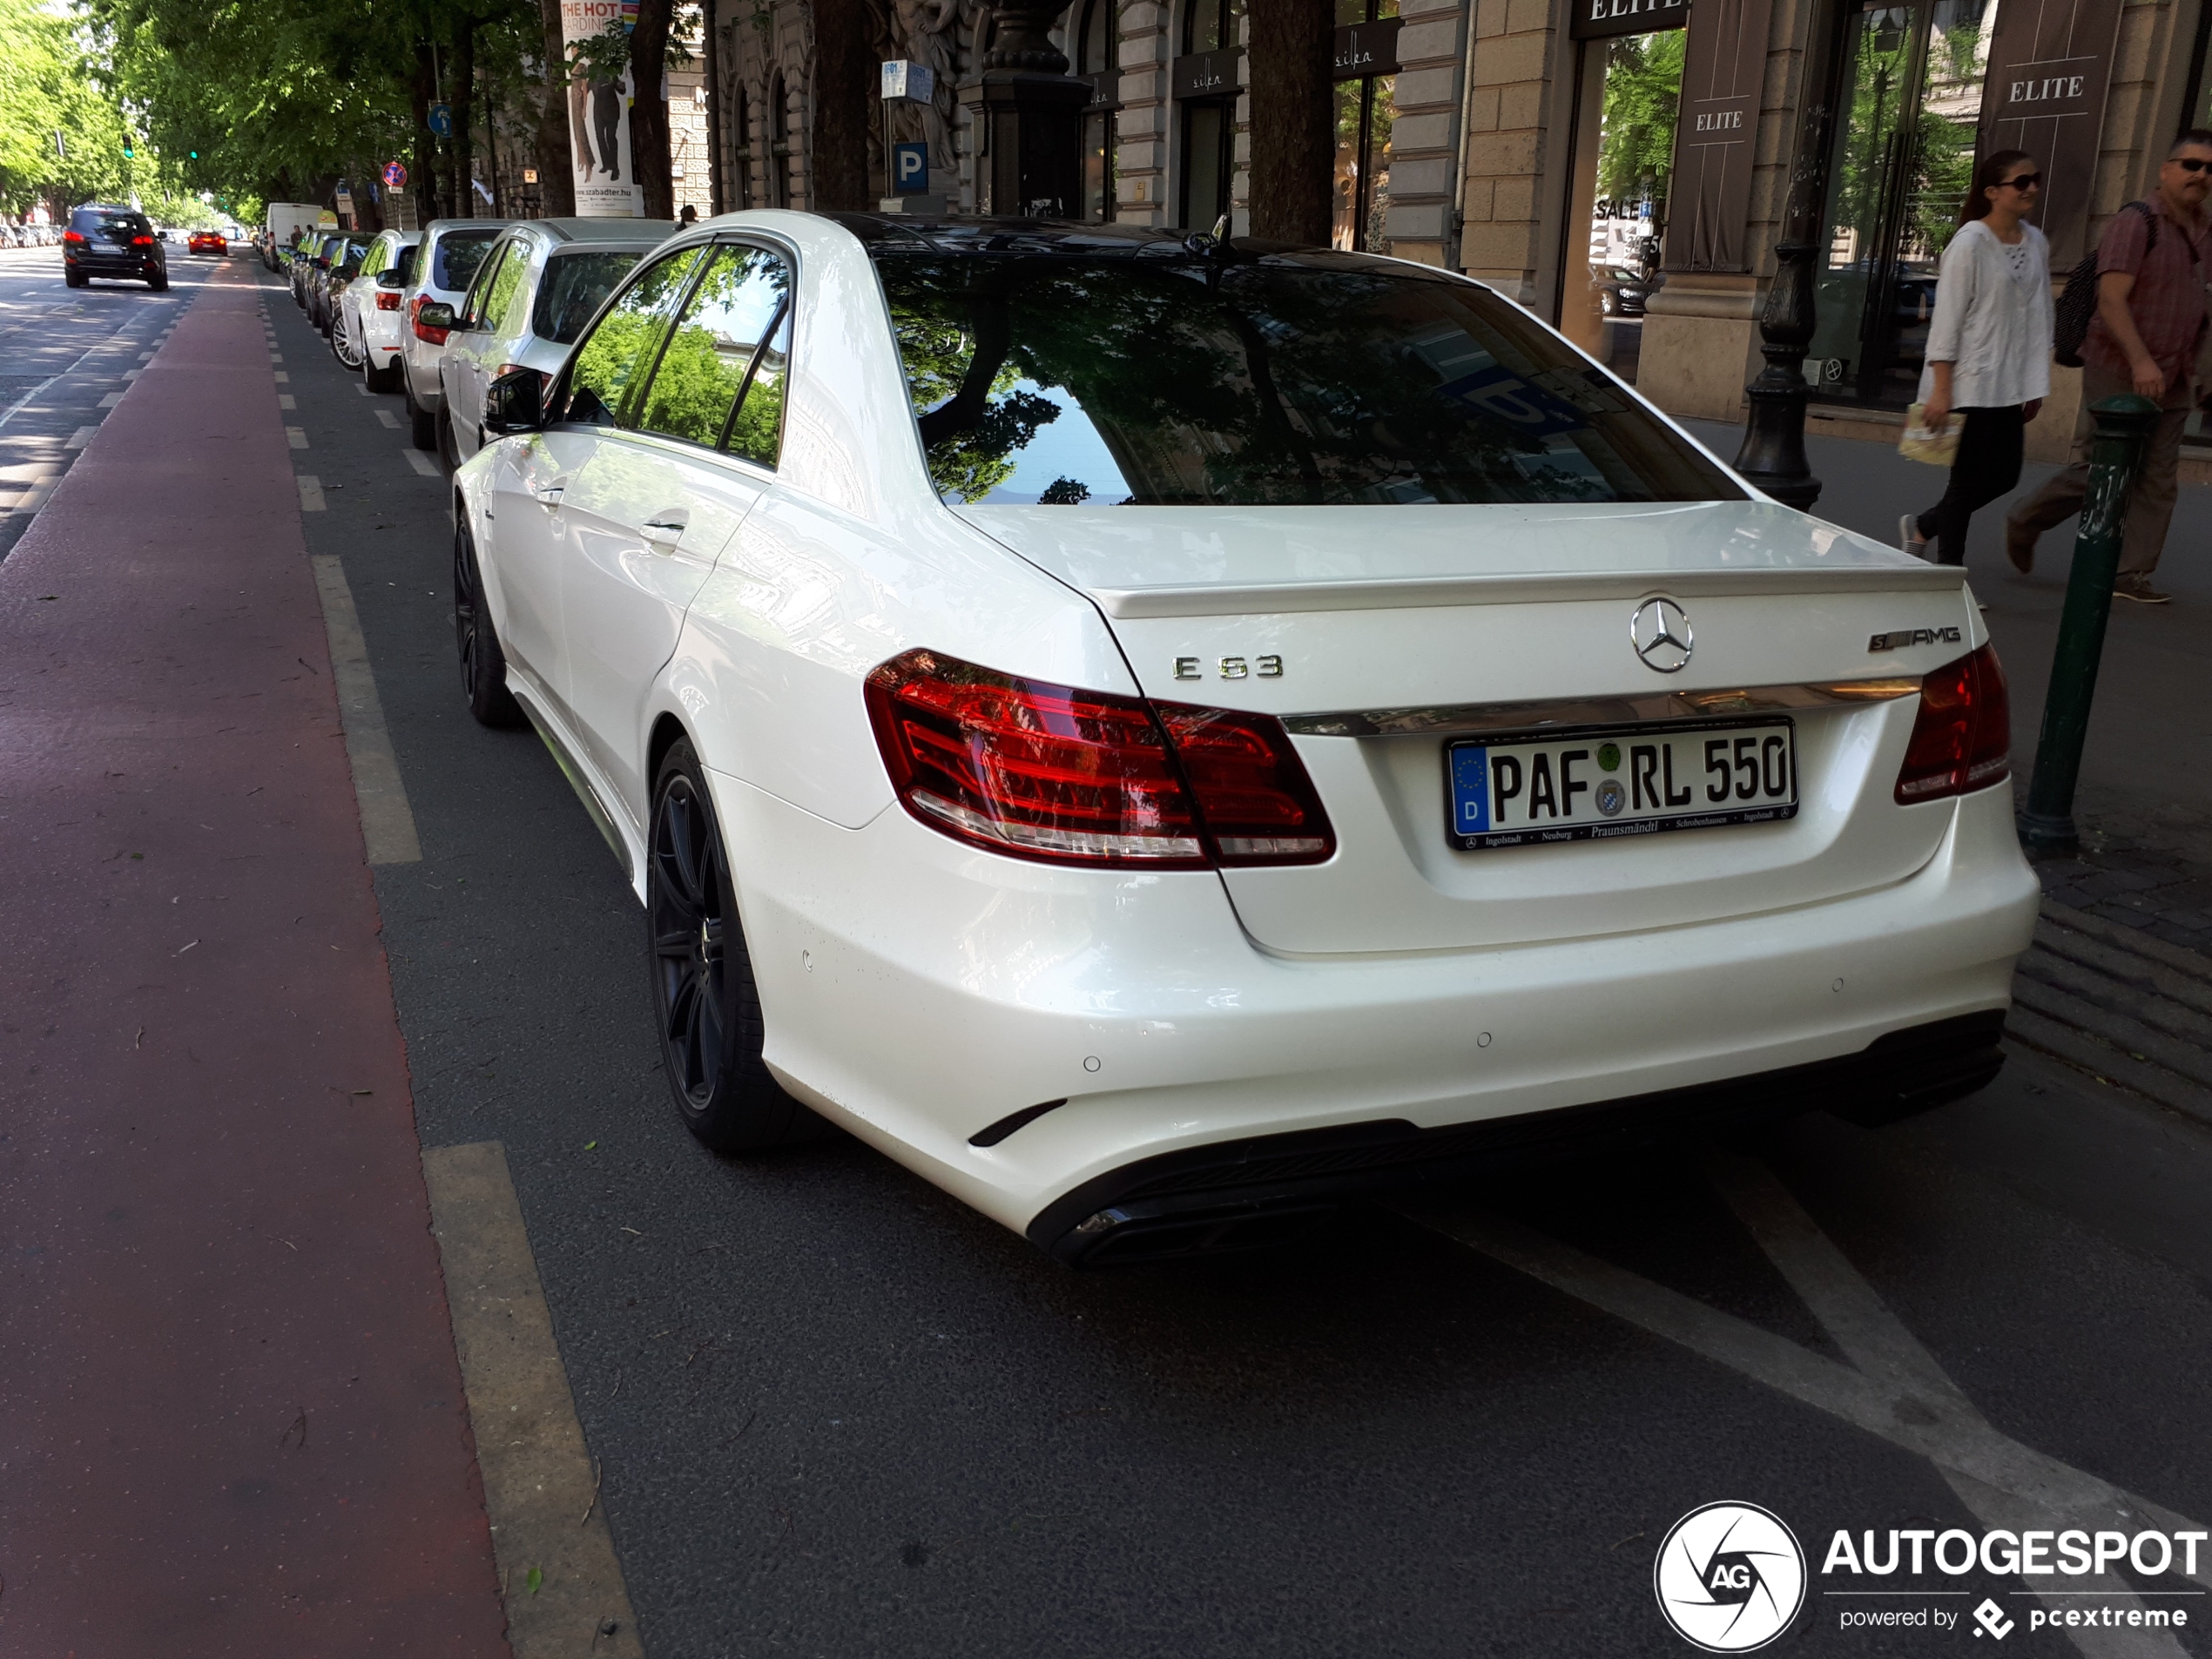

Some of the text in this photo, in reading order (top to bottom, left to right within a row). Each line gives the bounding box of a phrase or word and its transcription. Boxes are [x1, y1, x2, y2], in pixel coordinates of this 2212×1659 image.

[563, 3, 617, 17] THE HOT
[1589, 0, 1682, 20] ELI
[563, 17, 610, 31] SARDINE
[2008, 76, 2084, 103] ELITE
[1696, 111, 1743, 132] ELITE
[900, 151, 922, 182] P
[1595, 199, 1641, 220] SALE
[1912, 627, 1961, 645] AMG
[1171, 655, 1283, 680] E 63
[1491, 736, 1786, 822] PAF RL 550
[1465, 801, 1478, 820] D
[1486, 810, 1775, 847] Ingolstadt Neuburg Praunsmändtl Schrobenhausen Ingolstadt
